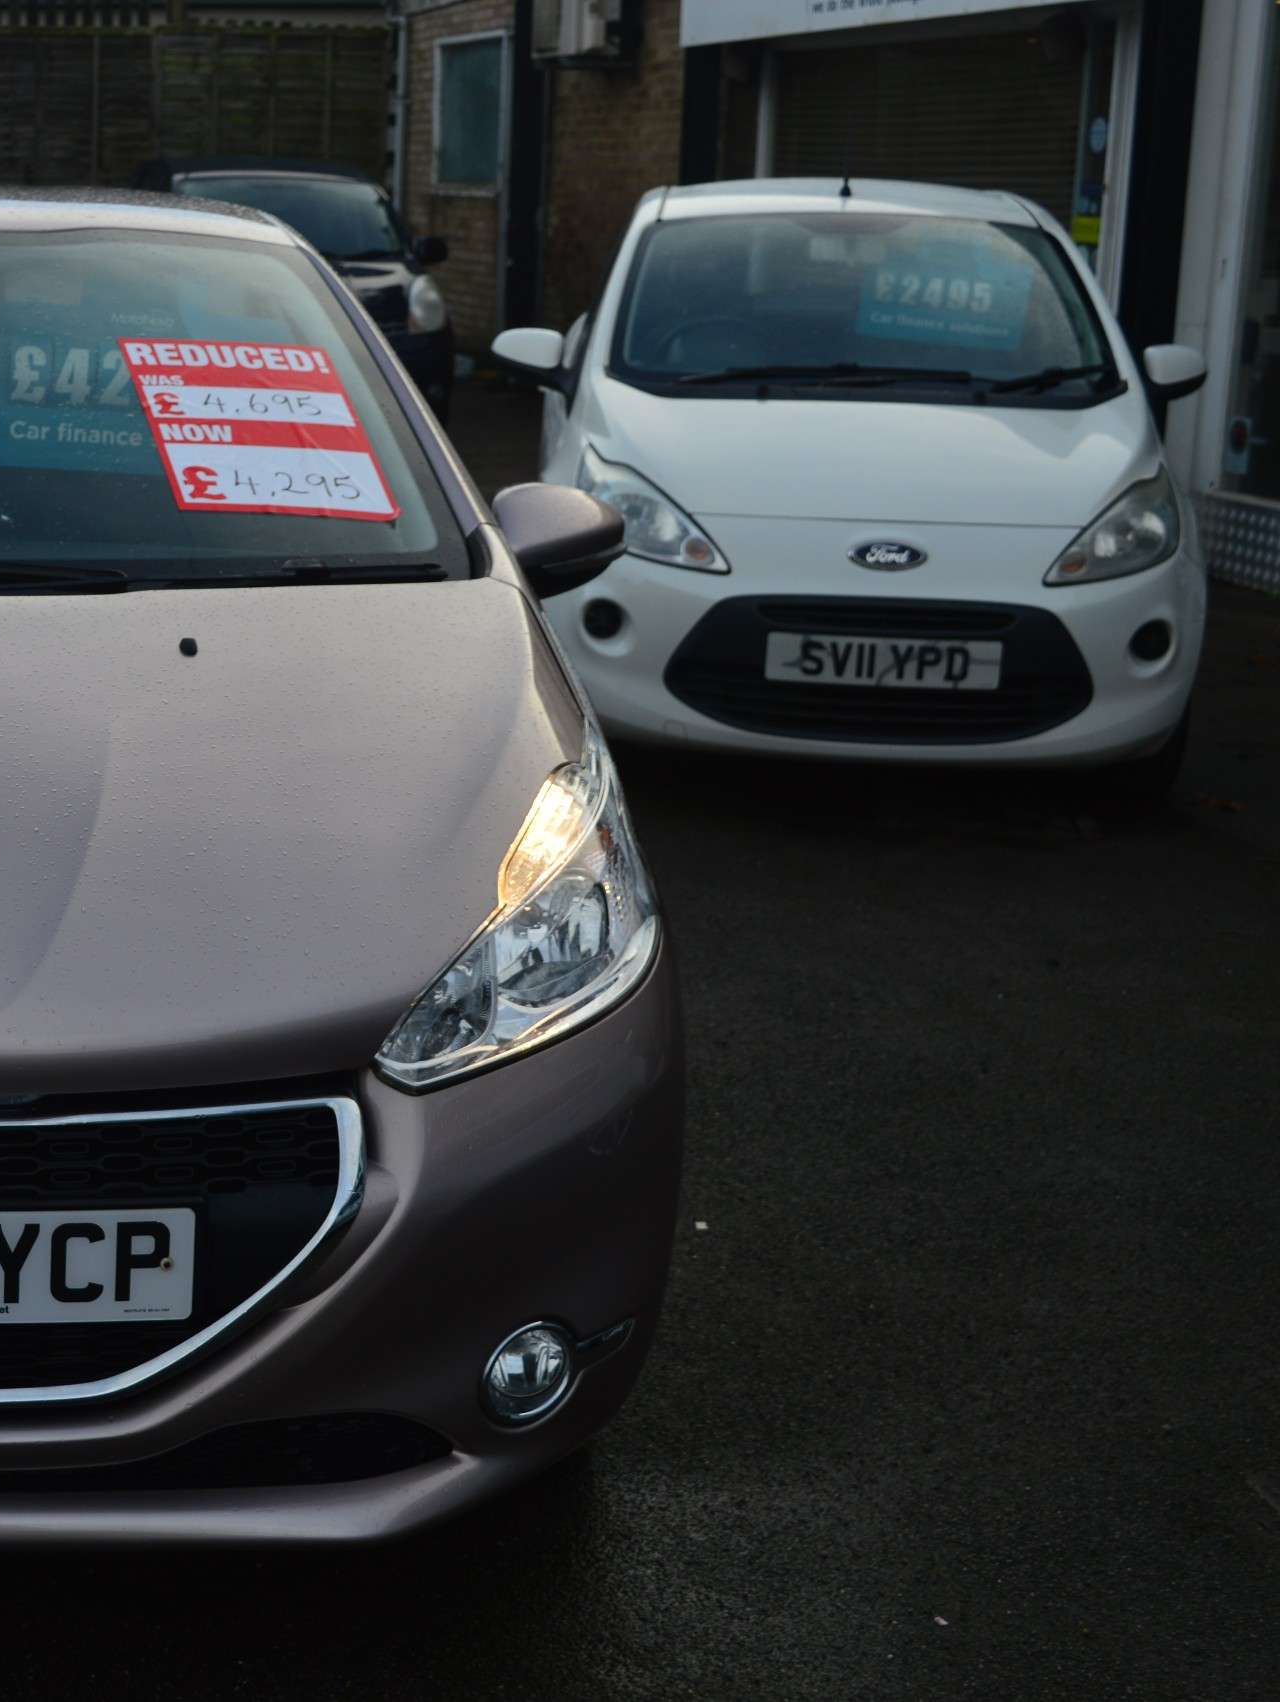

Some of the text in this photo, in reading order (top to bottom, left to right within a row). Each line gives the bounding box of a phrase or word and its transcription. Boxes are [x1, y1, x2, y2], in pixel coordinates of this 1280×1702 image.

[874, 271, 992, 313] £2495
[124, 342, 330, 375] REDUCED!
[138, 374, 185, 386] WAS
[153, 392, 186, 416] £
[9, 420, 143, 446] Car finance
[158, 423, 233, 443] NOW
[182, 465, 227, 500] £
[865, 545, 911, 564] Ford
[800, 638, 970, 682] SV11 YPD
